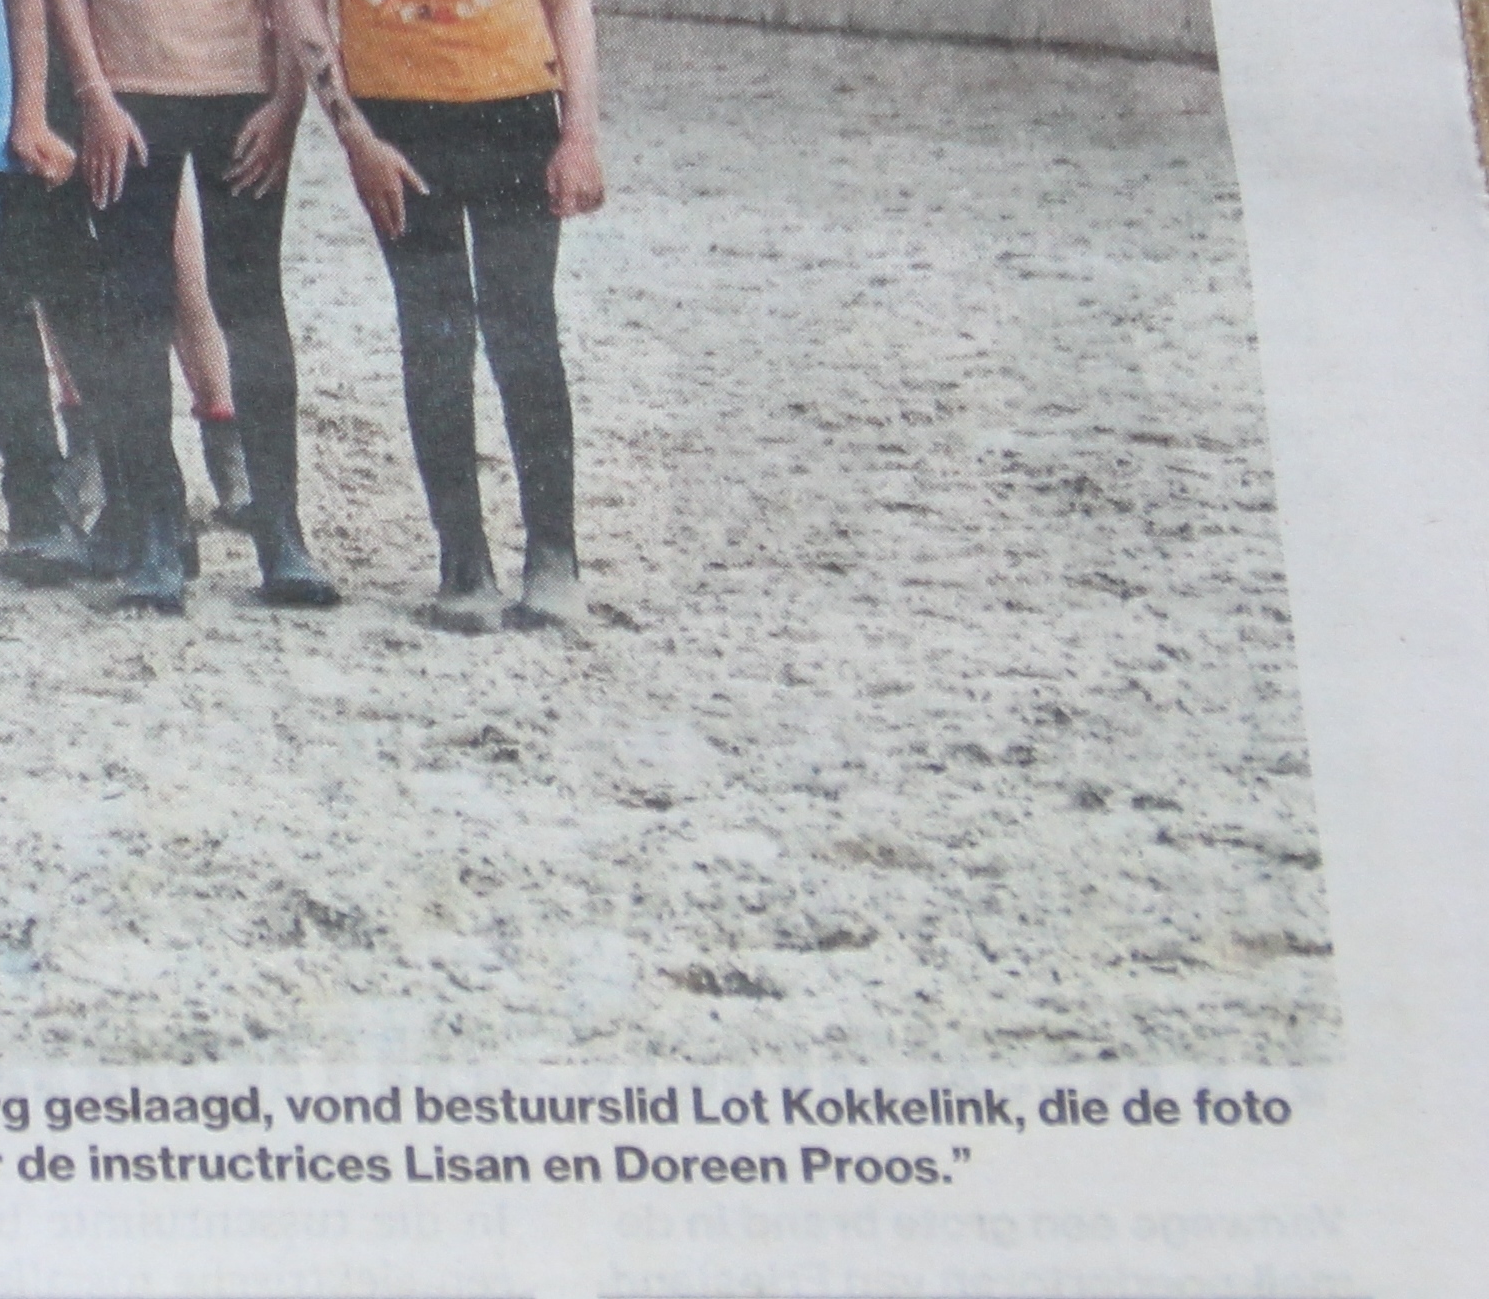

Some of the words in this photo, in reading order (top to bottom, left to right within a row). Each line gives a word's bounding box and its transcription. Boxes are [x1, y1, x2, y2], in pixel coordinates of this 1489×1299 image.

[45, 1086, 272, 1131] geslaagd,
[286, 1086, 400, 1123] vond
[416, 1086, 678, 1124] bestuurslid
[693, 1086, 769, 1124] Lot
[783, 1087, 1025, 1132] Kokkelink,
[1039, 1088, 1108, 1125] die
[1123, 1088, 1179, 1125] de
[1194, 1088, 1291, 1125] foto
[18, 1145, 74, 1181] de
[90, 1145, 391, 1182] instructrices
[406, 1145, 529, 1182] Lisan
[544, 1155, 601, 1182] en
[615, 1146, 787, 1183] Doreen
